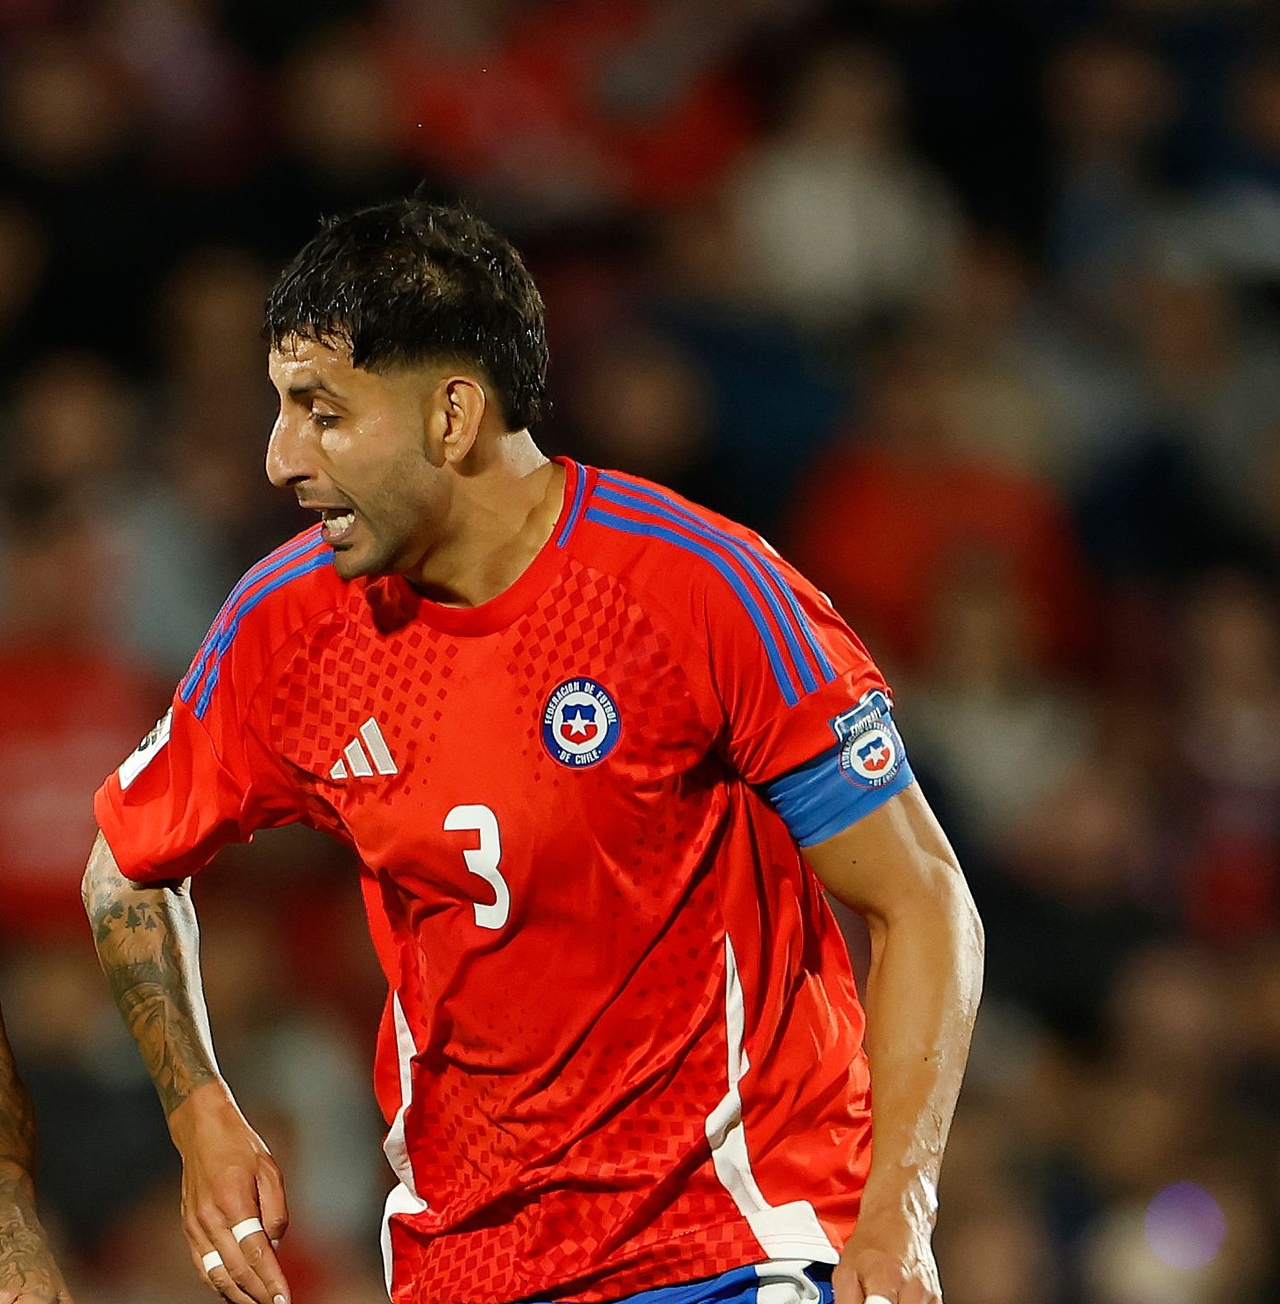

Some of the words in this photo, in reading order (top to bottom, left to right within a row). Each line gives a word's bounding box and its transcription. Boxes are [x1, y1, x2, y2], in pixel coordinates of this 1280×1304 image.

[584, 682, 596, 695] DE
[596, 690, 617, 725] FUTBOL
[559, 750, 572, 763] DE
[575, 749, 600, 765] CHILE
[442, 803, 511, 930] 3
